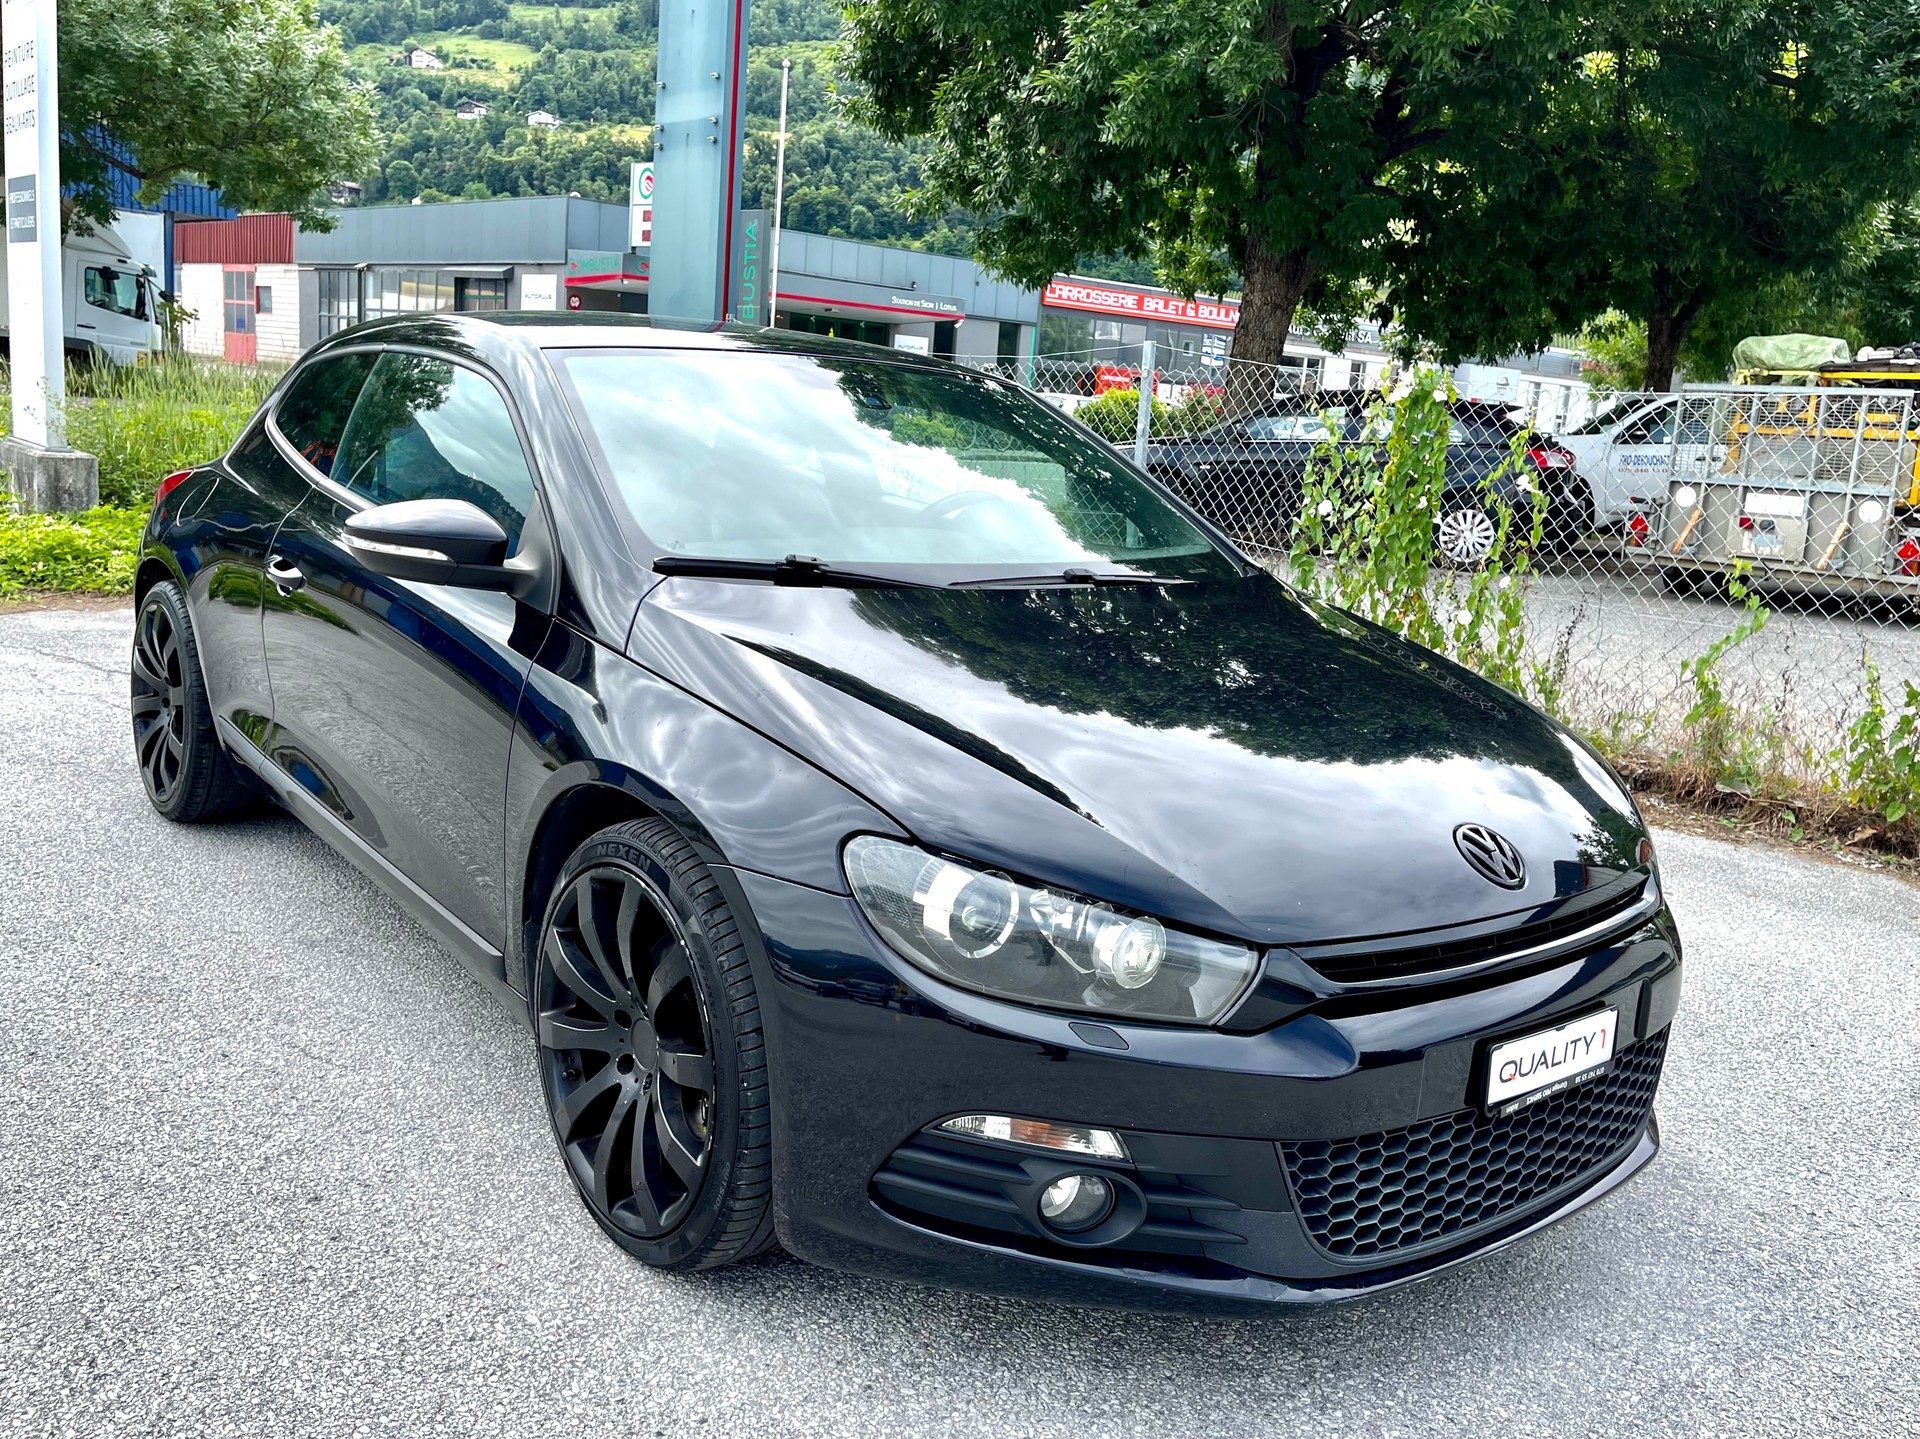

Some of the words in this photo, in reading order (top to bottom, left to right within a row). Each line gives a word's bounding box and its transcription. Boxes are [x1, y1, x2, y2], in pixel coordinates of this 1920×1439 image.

[1046, 284, 1138, 309] CARROSSERIE
[1143, 297, 1185, 315] BALET
[1186, 303, 1196, 317] &
[596, 843, 652, 873] NEXEN
